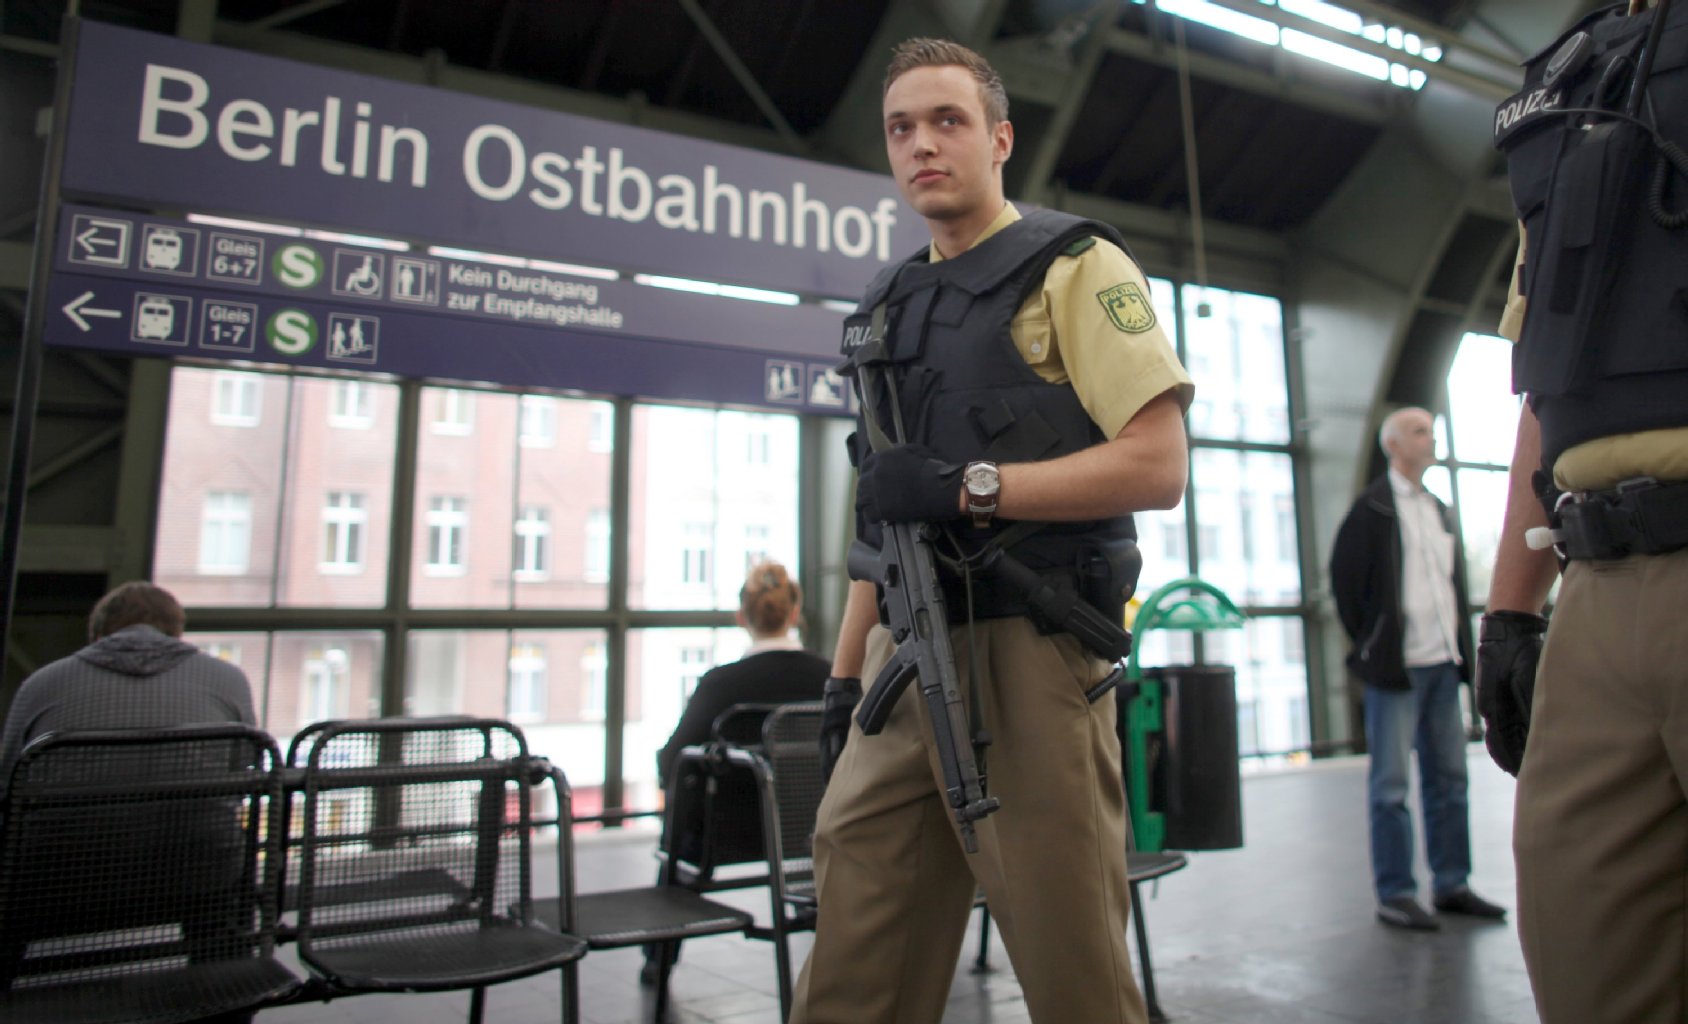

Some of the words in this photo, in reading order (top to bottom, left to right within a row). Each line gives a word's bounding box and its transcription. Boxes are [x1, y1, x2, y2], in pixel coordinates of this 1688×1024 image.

[138, 63, 430, 188] Berlin
[462, 124, 898, 261] Ostbahnhof
[216, 238, 257, 258] Gleis
[214, 255, 257, 277] 6+7
[281, 245, 317, 288] S
[449, 263, 493, 287] Kein
[497, 269, 599, 305] Durchgang
[209, 305, 251, 325] Gleis
[448, 291, 480, 311] zur
[484, 292, 624, 329] Empfangshalle
[211, 323, 246, 344] 1-7
[273, 311, 311, 354] S
[843, 324, 888, 348] POLI
